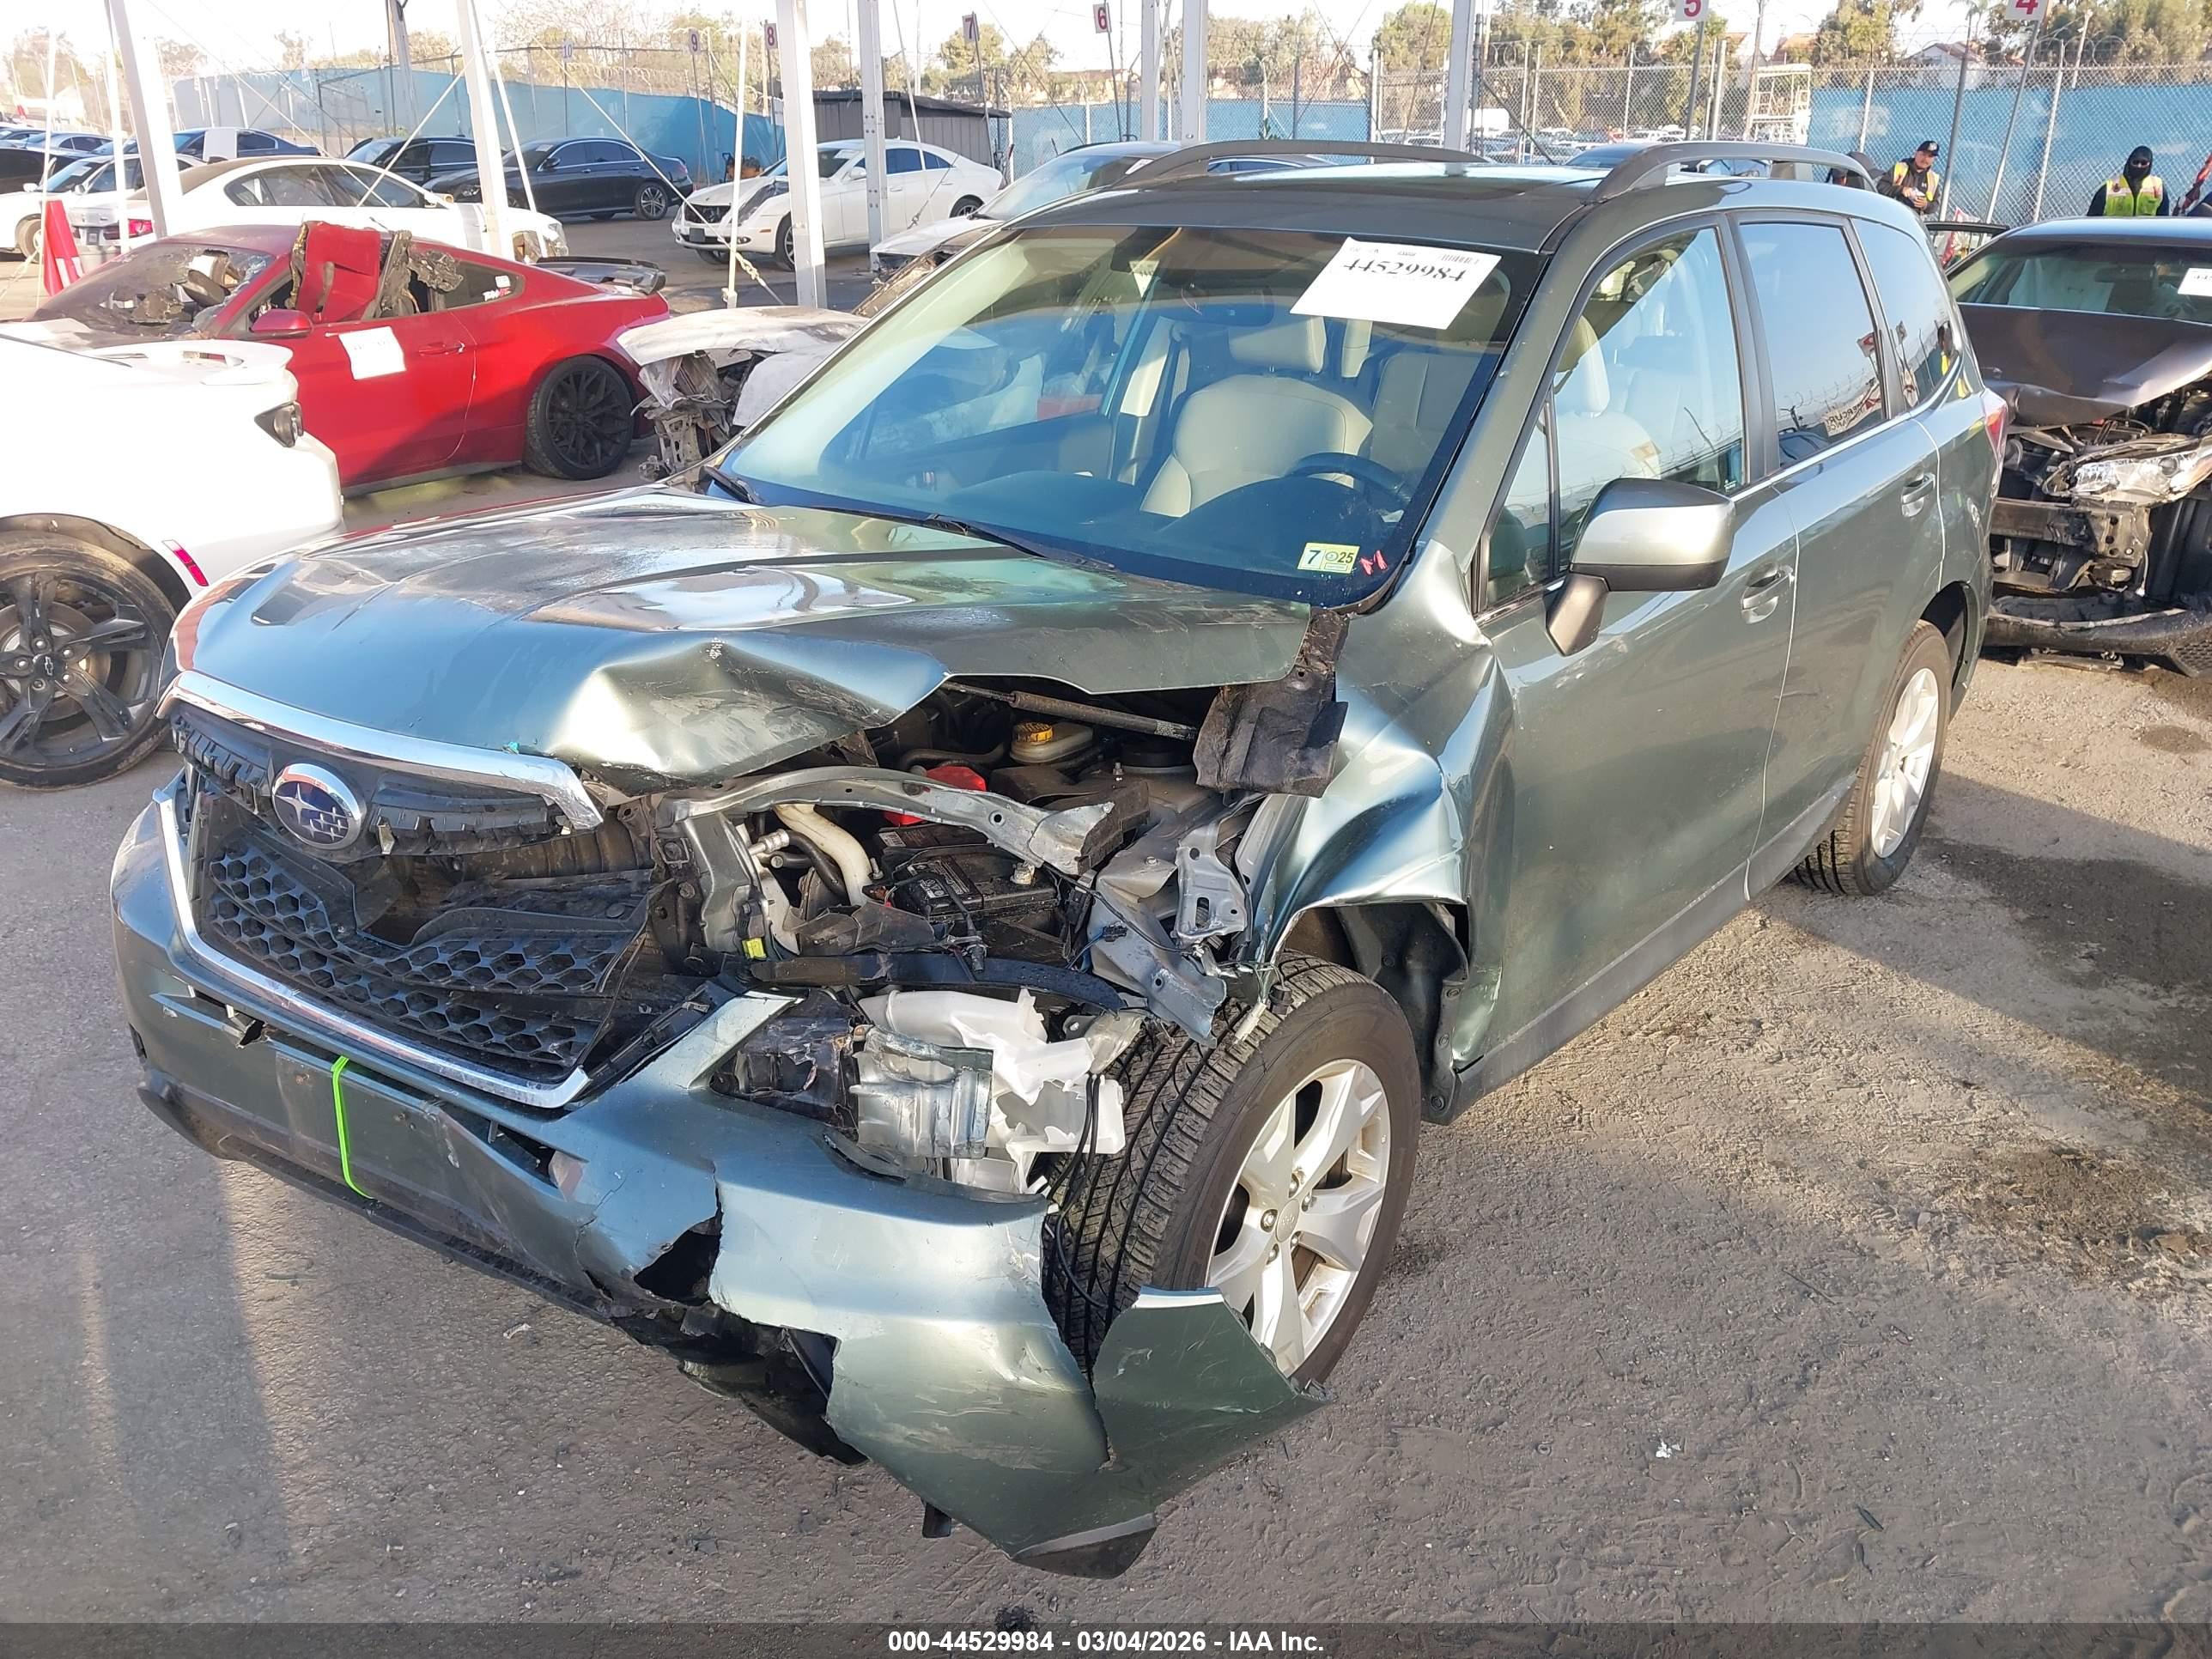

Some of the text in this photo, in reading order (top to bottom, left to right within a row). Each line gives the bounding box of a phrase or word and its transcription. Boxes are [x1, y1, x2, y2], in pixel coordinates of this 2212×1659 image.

[1683, 0, 1702, 17] 5
[1097, 7, 1108, 30] 6
[767, 27, 775, 46] 8
[964, 17, 975, 40] 7
[562, 44, 573, 58] 10
[690, 33, 698, 52] 9
[1343, 258, 1467, 282] 44529984
[1307, 550, 1354, 564] 7 25
